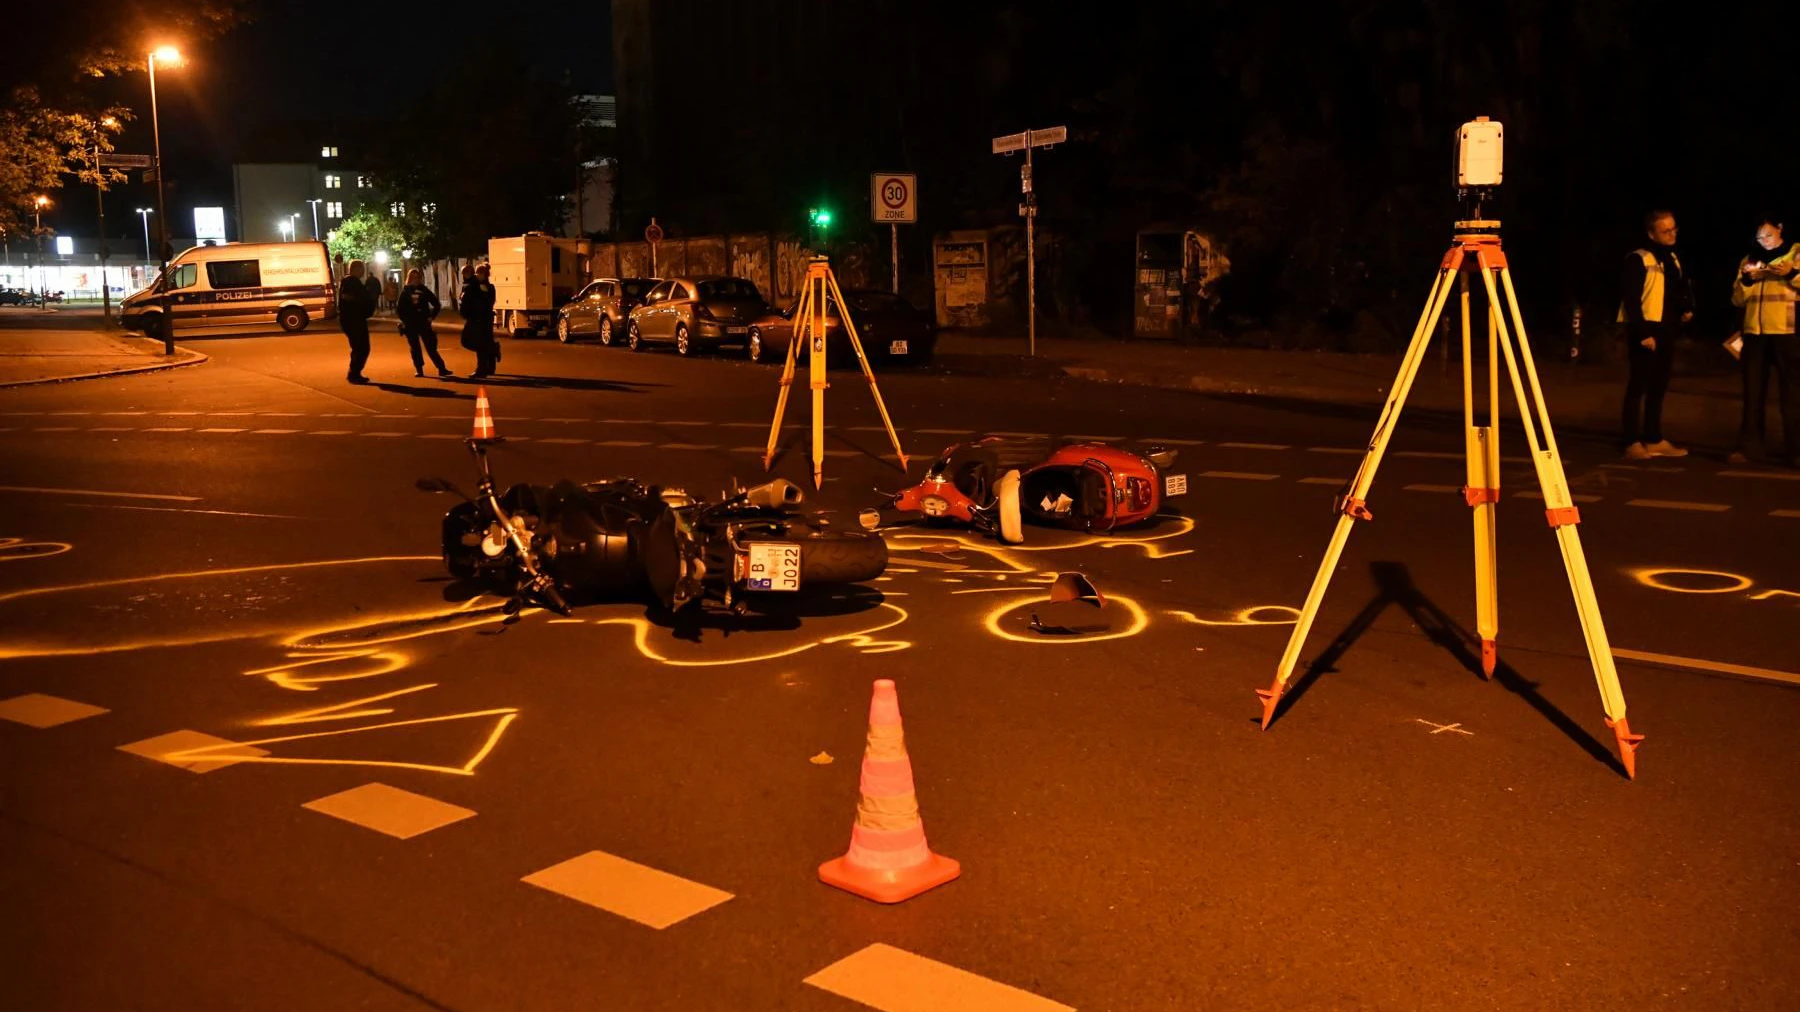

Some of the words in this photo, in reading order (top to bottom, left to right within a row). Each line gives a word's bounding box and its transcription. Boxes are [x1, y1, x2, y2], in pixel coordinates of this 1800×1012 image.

[887, 186, 903, 200] 30
[884, 210, 905, 219] ZONE
[216, 291, 252, 301] POLIZEI
[751, 564, 765, 573] B
